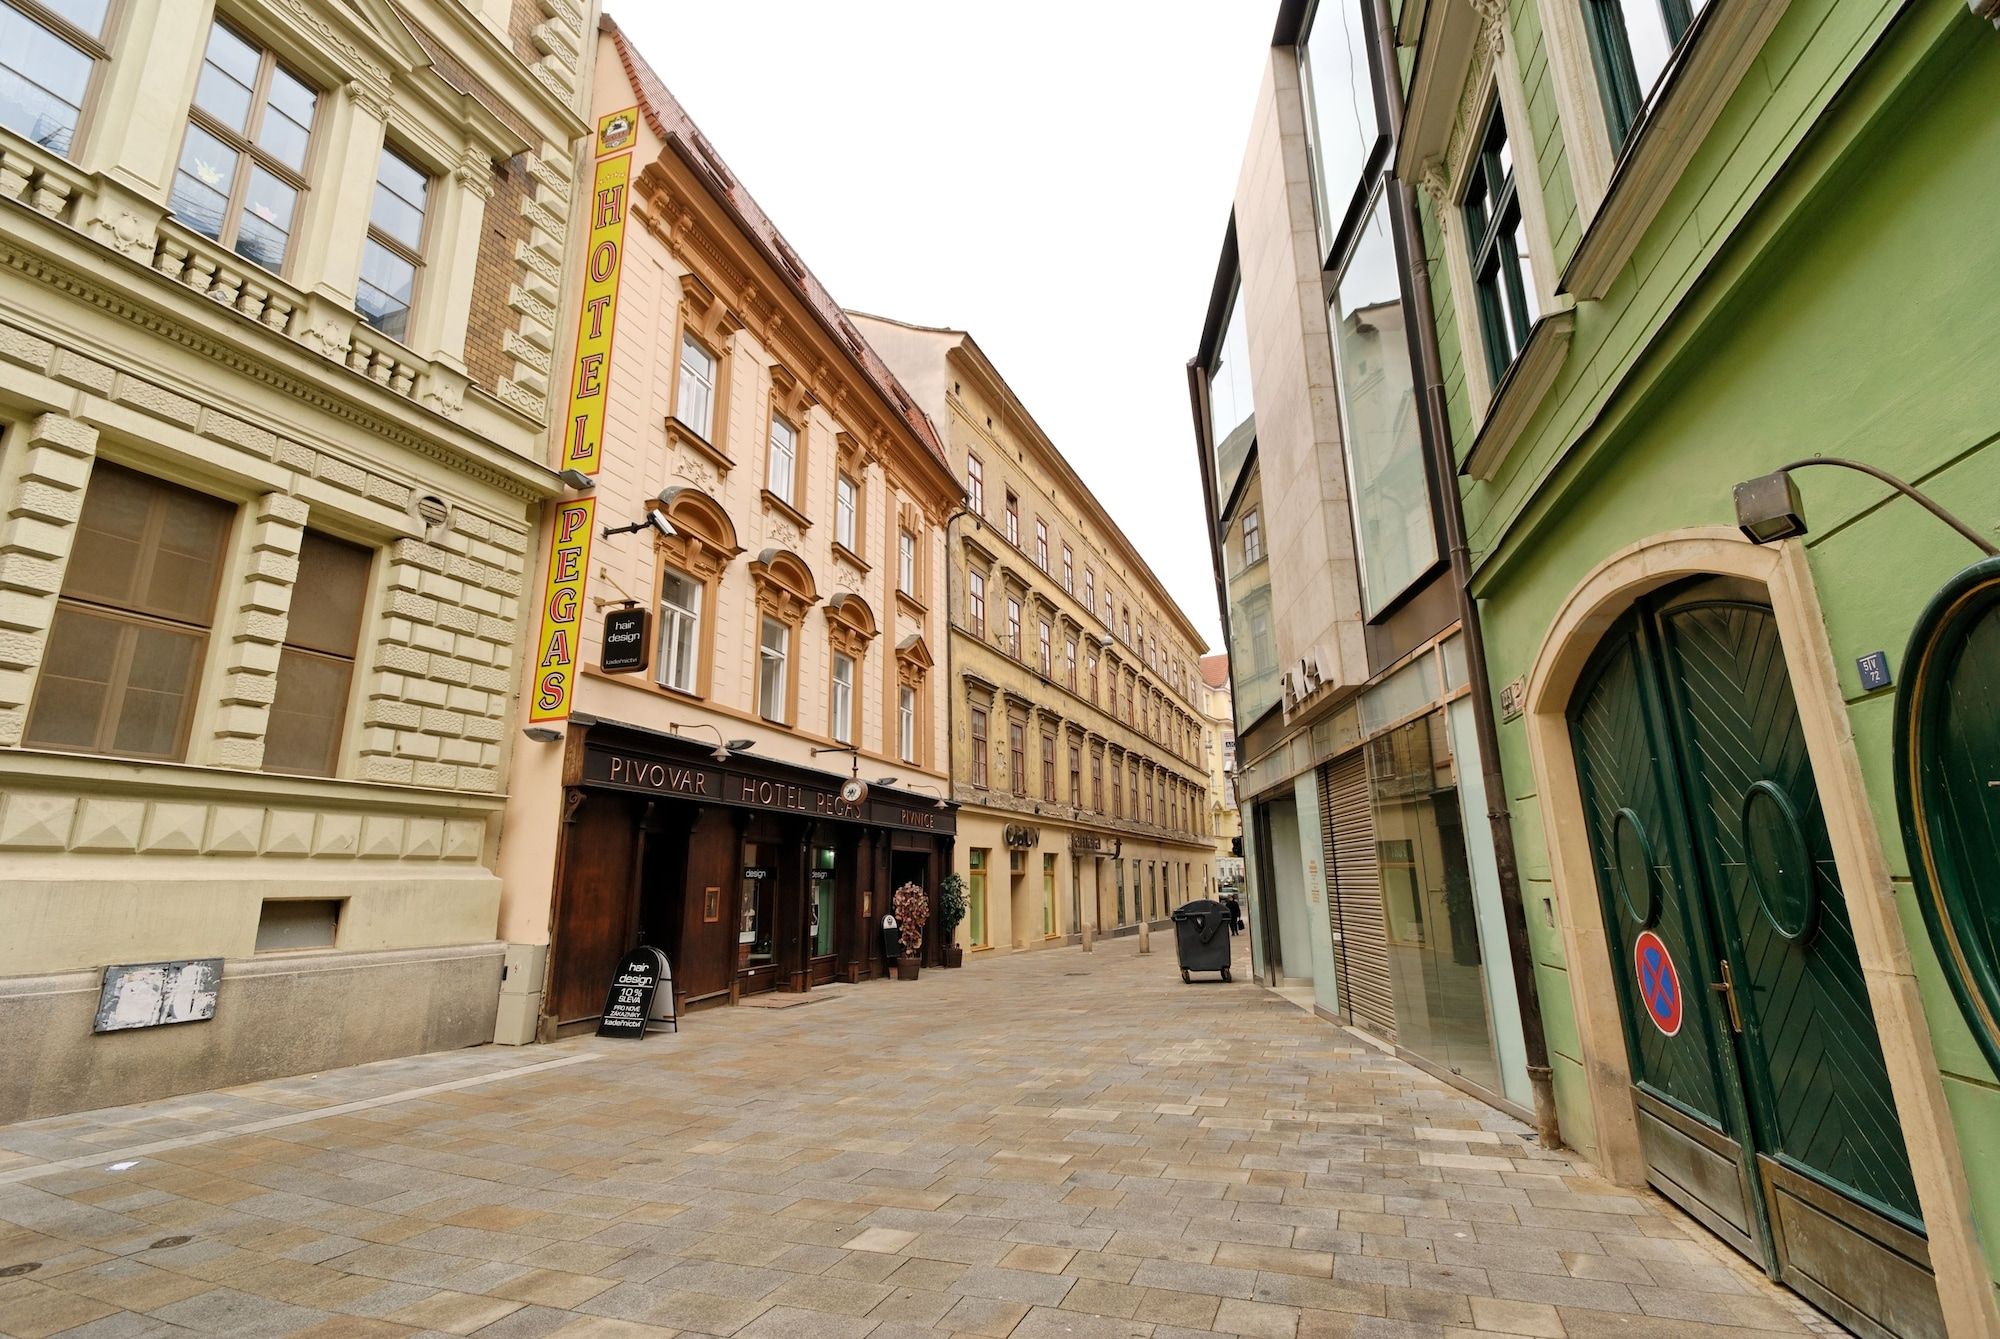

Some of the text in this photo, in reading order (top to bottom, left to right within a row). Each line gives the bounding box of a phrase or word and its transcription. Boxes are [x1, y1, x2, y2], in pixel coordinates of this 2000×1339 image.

[571, 184, 624, 460] HOTEL
[538, 507, 587, 711] PEGAS
[615, 620, 635, 630] hair
[608, 632, 640, 643] design
[610, 756, 706, 795] PIVOVAR
[741, 777, 806, 811] HOTEL
[901, 809, 935, 829] PIVNICE
[745, 869, 767, 879] design
[628, 962, 650, 972] hair
[618, 973, 653, 986] design
[618, 995, 641, 1004] SLEVA
